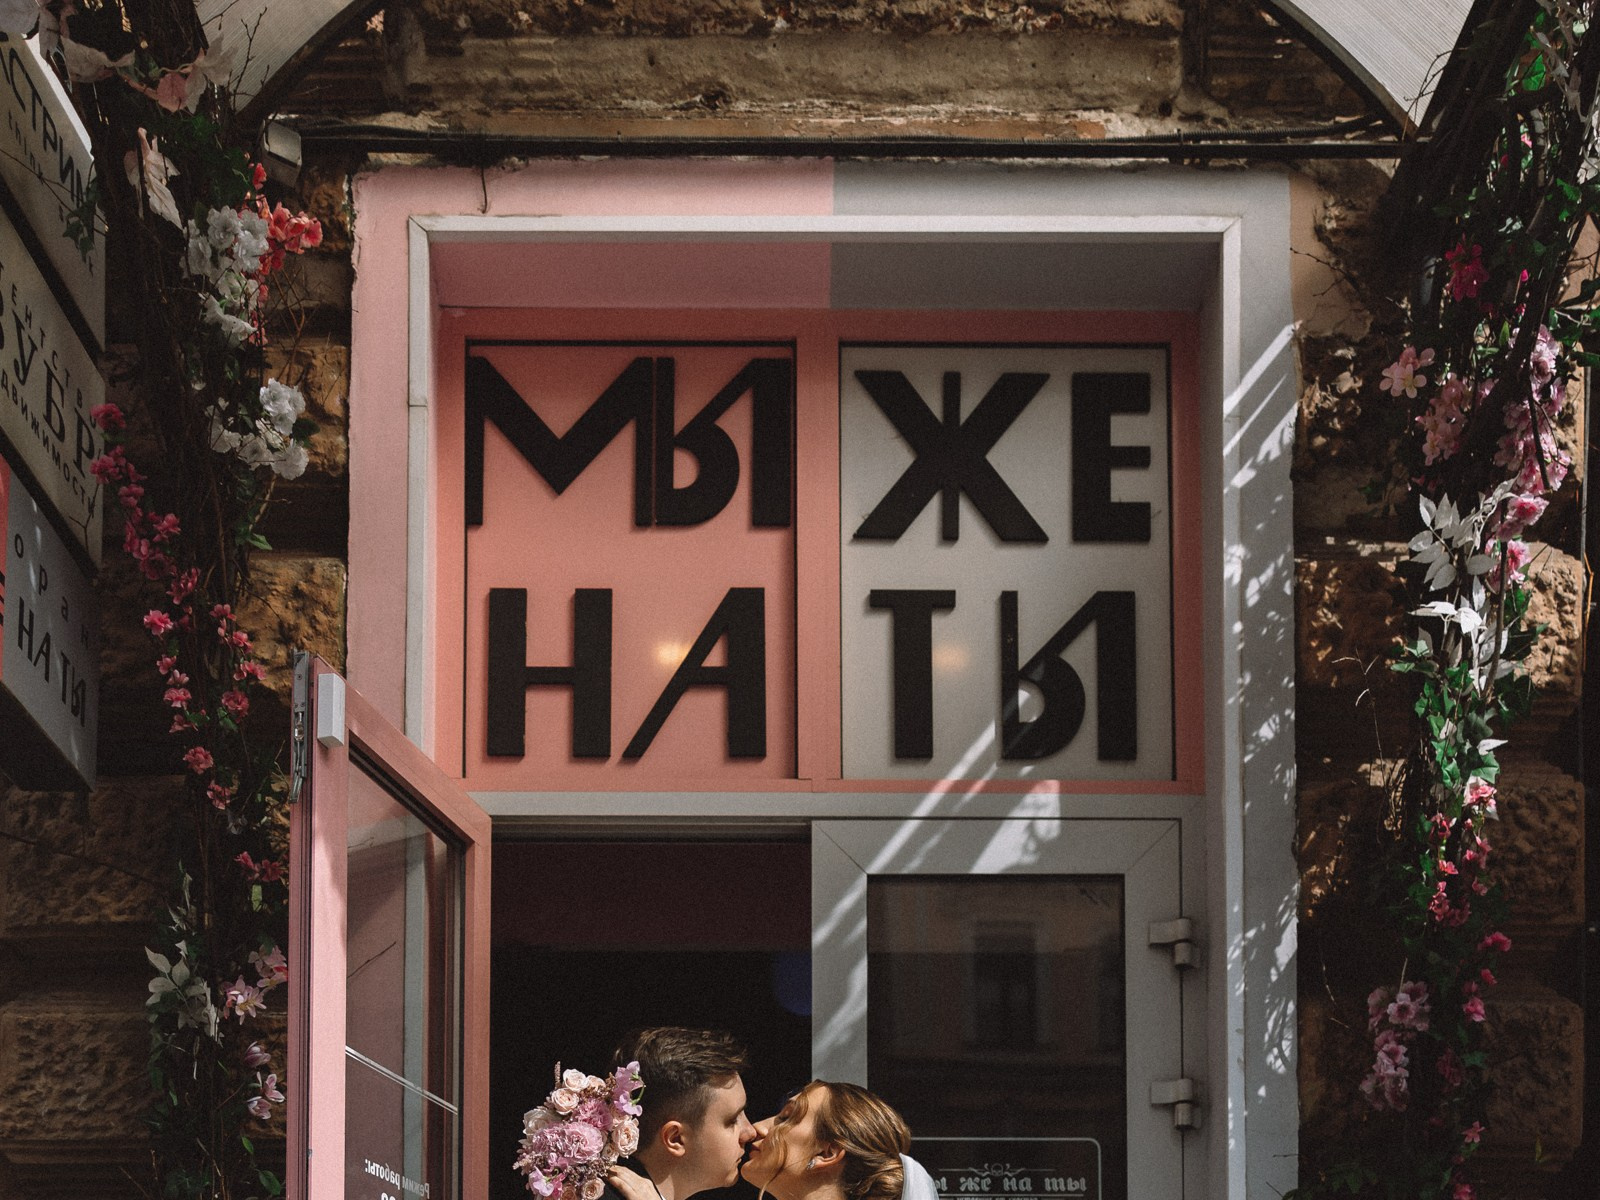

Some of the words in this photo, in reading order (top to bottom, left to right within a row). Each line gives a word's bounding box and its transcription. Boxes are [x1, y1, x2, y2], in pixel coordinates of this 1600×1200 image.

[465, 356, 792, 529] МЫ
[853, 370, 1152, 543] ЖЕ
[17, 597, 49, 684] НА
[61, 652, 86, 728] ТЫ
[487, 587, 767, 761] НА
[869, 589, 1137, 762] ТЫ
[959, 1176, 992, 1192] же
[1002, 1176, 1033, 1192] на
[1044, 1176, 1087, 1192] ты
